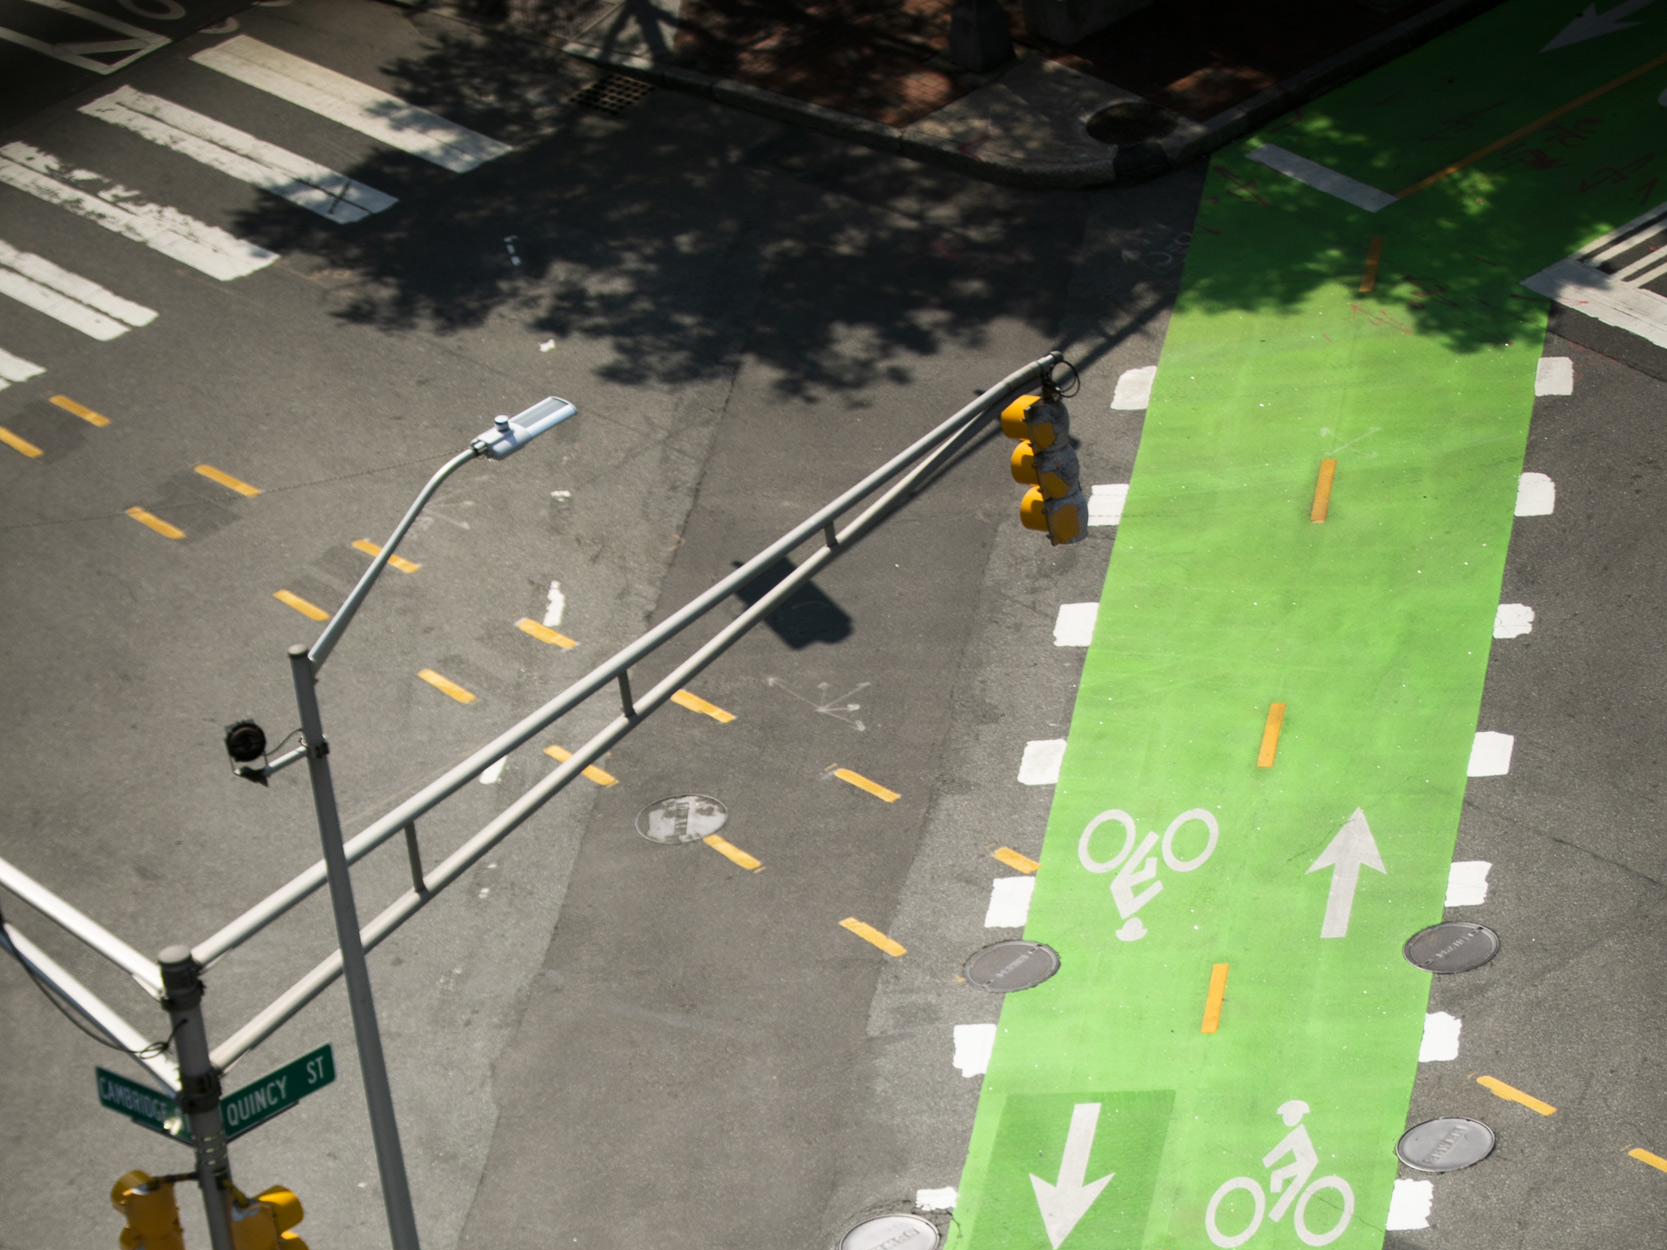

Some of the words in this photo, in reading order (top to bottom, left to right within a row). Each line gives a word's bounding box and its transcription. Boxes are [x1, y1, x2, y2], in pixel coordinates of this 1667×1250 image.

[99, 1076, 168, 1123] CAMBRIDGE
[226, 1075, 287, 1127] QUINCY
[306, 1055, 324, 1085] ST
